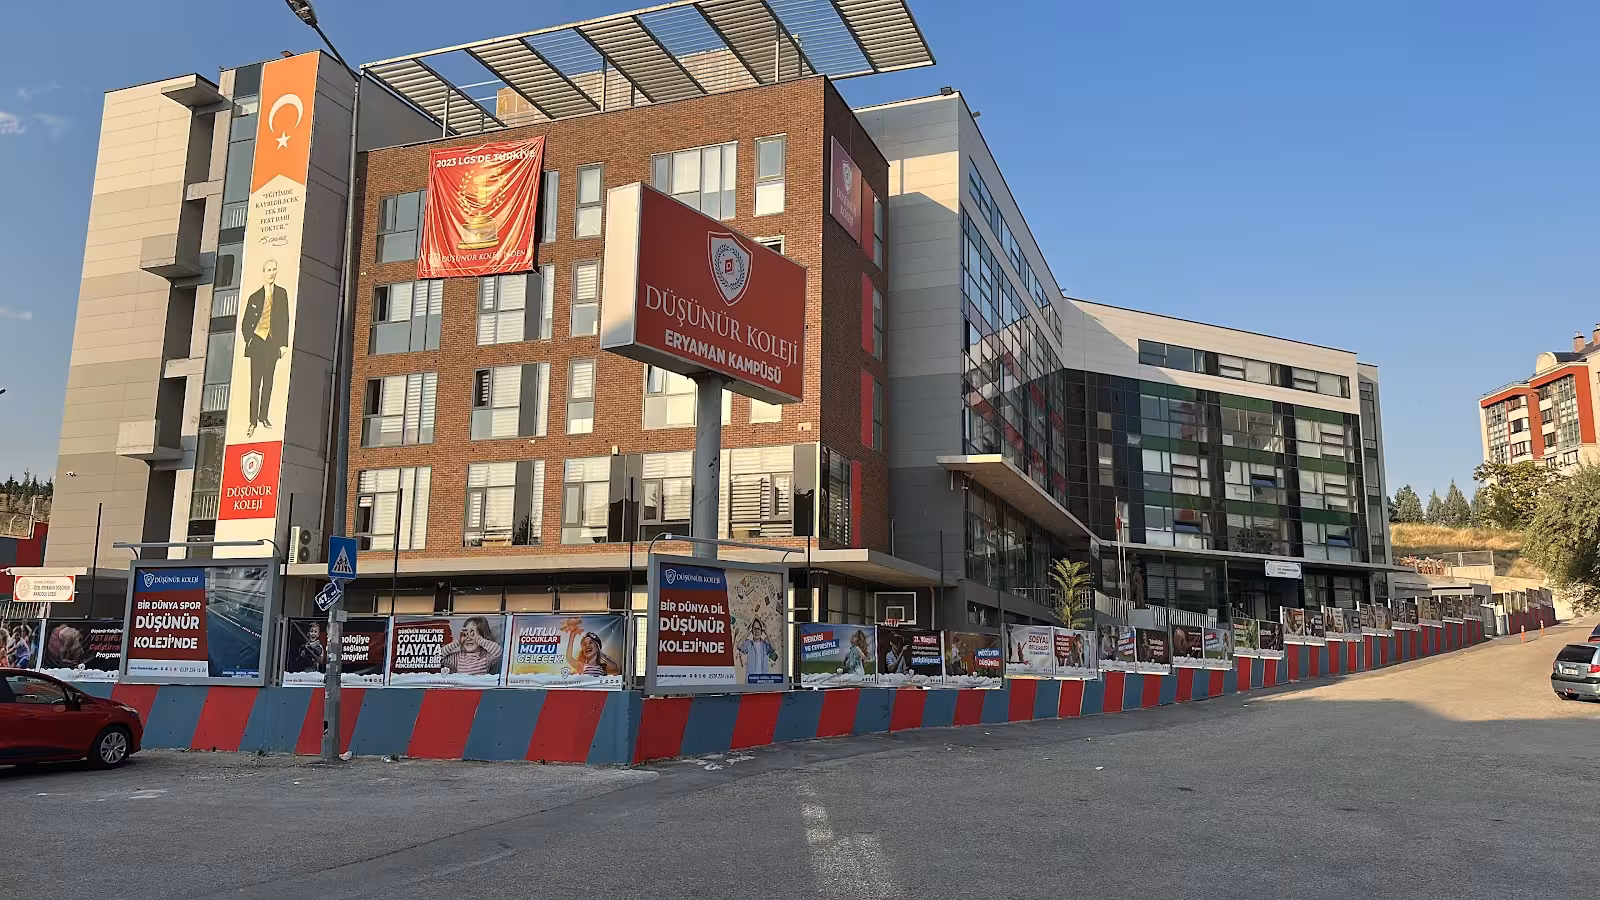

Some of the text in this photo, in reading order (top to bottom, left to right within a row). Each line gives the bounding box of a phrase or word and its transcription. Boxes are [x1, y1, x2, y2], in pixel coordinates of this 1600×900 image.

[435, 159, 457, 168] 2023
[458, 153, 491, 165] LGS'DE
[265, 207, 276, 216] TEK
[644, 283, 798, 368] DÜŞÜNÜR KOLEJİ
[664, 328, 782, 385] ERYAMAN KAMPÜSÜ
[226, 484, 273, 499] DÜŞÜNÜR
[233, 498, 263, 512] KOLEJİ
[154, 575, 181, 585] DÜŞÜNÜR
[676, 573, 703, 583] DÜŞÜNÜR
[137, 599, 202, 610] BİR DÜNYA SPOR
[660, 598, 726, 615] BİR DÜNYA DİL
[135, 613, 200, 632] DÜŞÜNÜR
[660, 615, 725, 636] DÜŞÜNÜR
[133, 633, 198, 649] KOLEJİ'NDE
[397, 633, 444, 645] ÇOCUKLAR
[520, 635, 558, 644] ÇOCUKLAR
[1028, 635, 1049, 644] SOSYAL
[343, 645, 369, 653] sağlayan
[396, 643, 442, 656] HAYATA
[519, 644, 556, 654] MUTLU
[659, 638, 725, 654] KOLEJİ'NDE
[95, 652, 121, 660] Program
[395, 655, 442, 664] ANLAMLI BİR
